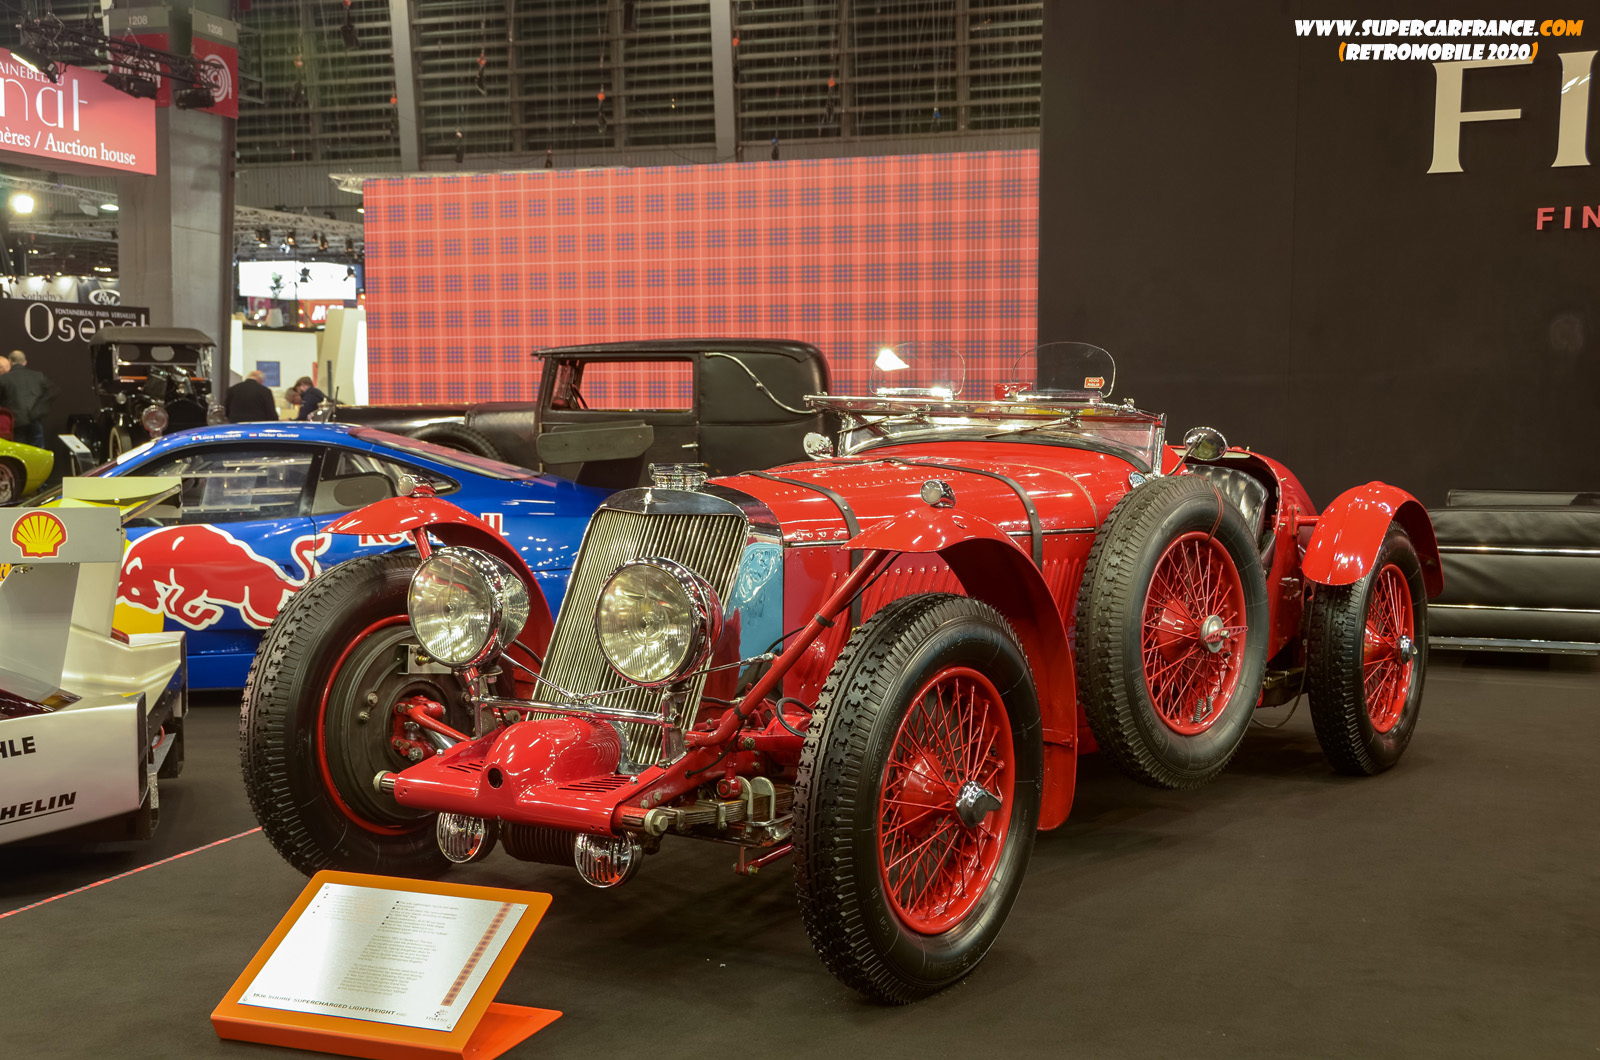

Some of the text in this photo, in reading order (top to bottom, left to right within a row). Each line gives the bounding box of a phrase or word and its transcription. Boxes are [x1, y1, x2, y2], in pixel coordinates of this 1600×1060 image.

[128, 15, 148, 25] 1208
[45, 133, 97, 159] Auction
[100, 143, 136, 165] house
[0, 791, 77, 821] HELIN
[348, 1004, 396, 1016] LIGHTWEIGHT
